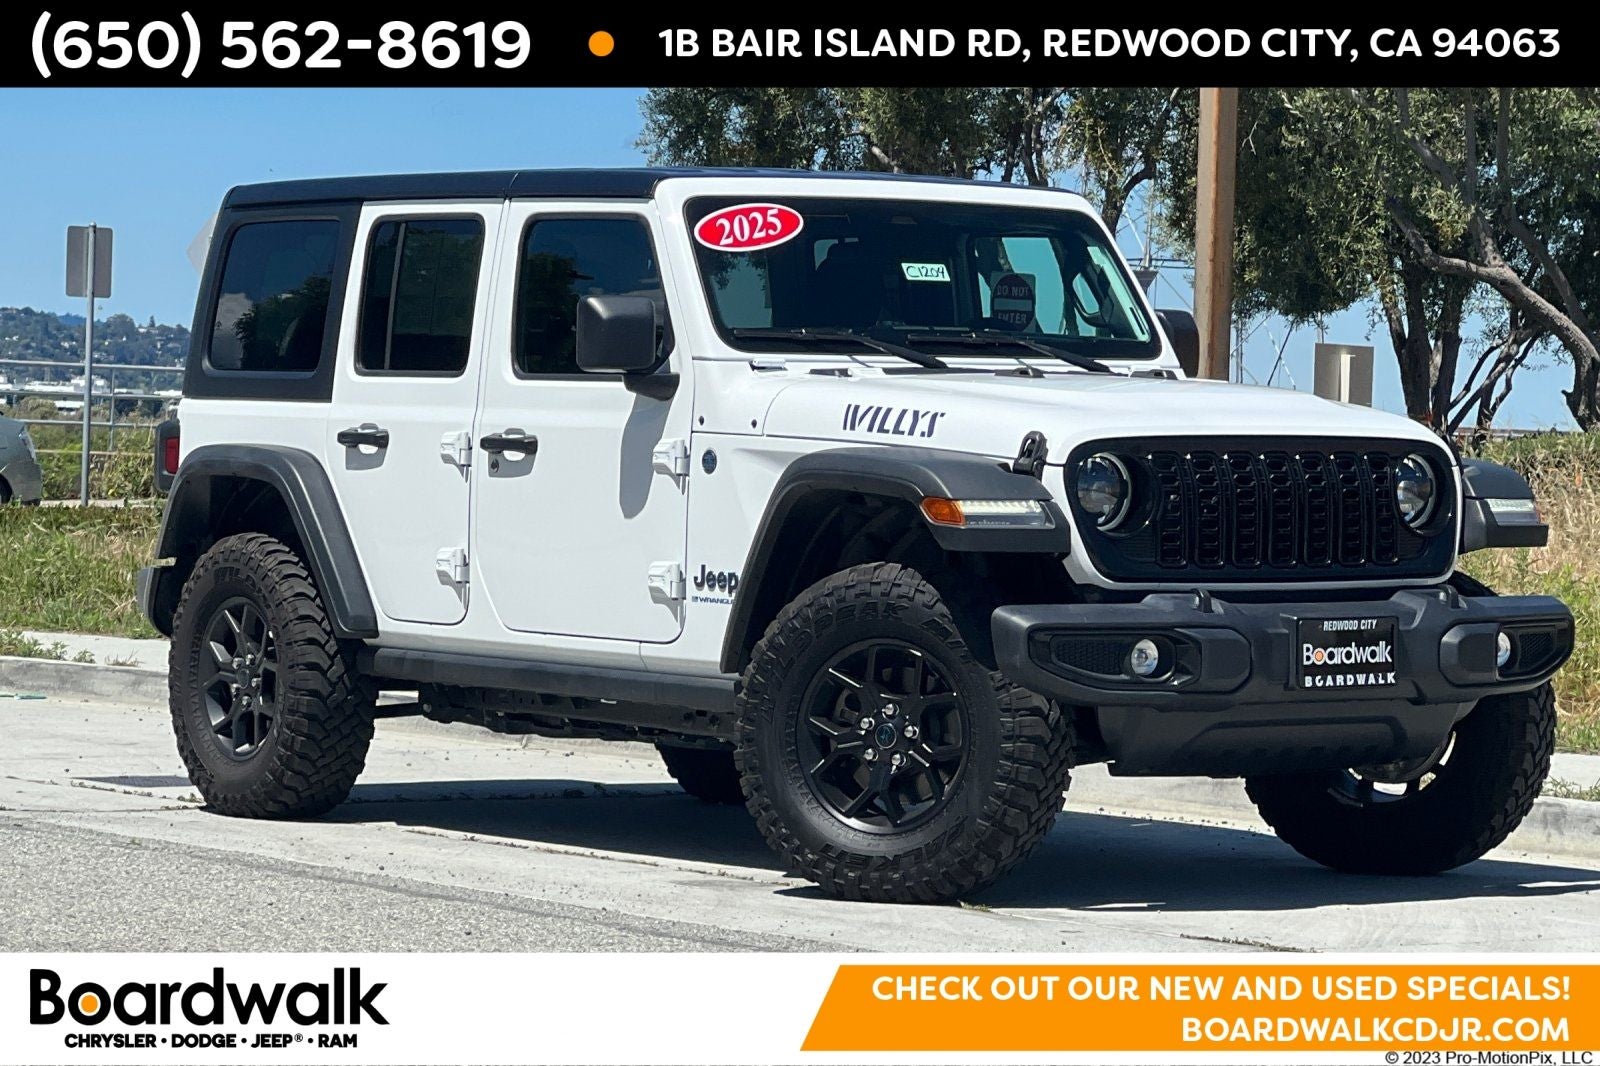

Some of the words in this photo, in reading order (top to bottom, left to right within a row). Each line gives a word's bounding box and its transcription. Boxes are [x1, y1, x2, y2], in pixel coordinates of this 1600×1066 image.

[716, 208, 782, 246] 2025
[906, 265, 946, 279] C1204
[997, 284, 1009, 296] DO
[1011, 286, 1029, 297] NOT
[842, 403, 946, 438] WILLYS
[693, 564, 739, 595] Jeep
[1323, 620, 1359, 632] REDWOOD
[1360, 619, 1378, 630] CITY
[1303, 640, 1393, 666] Boardwalk
